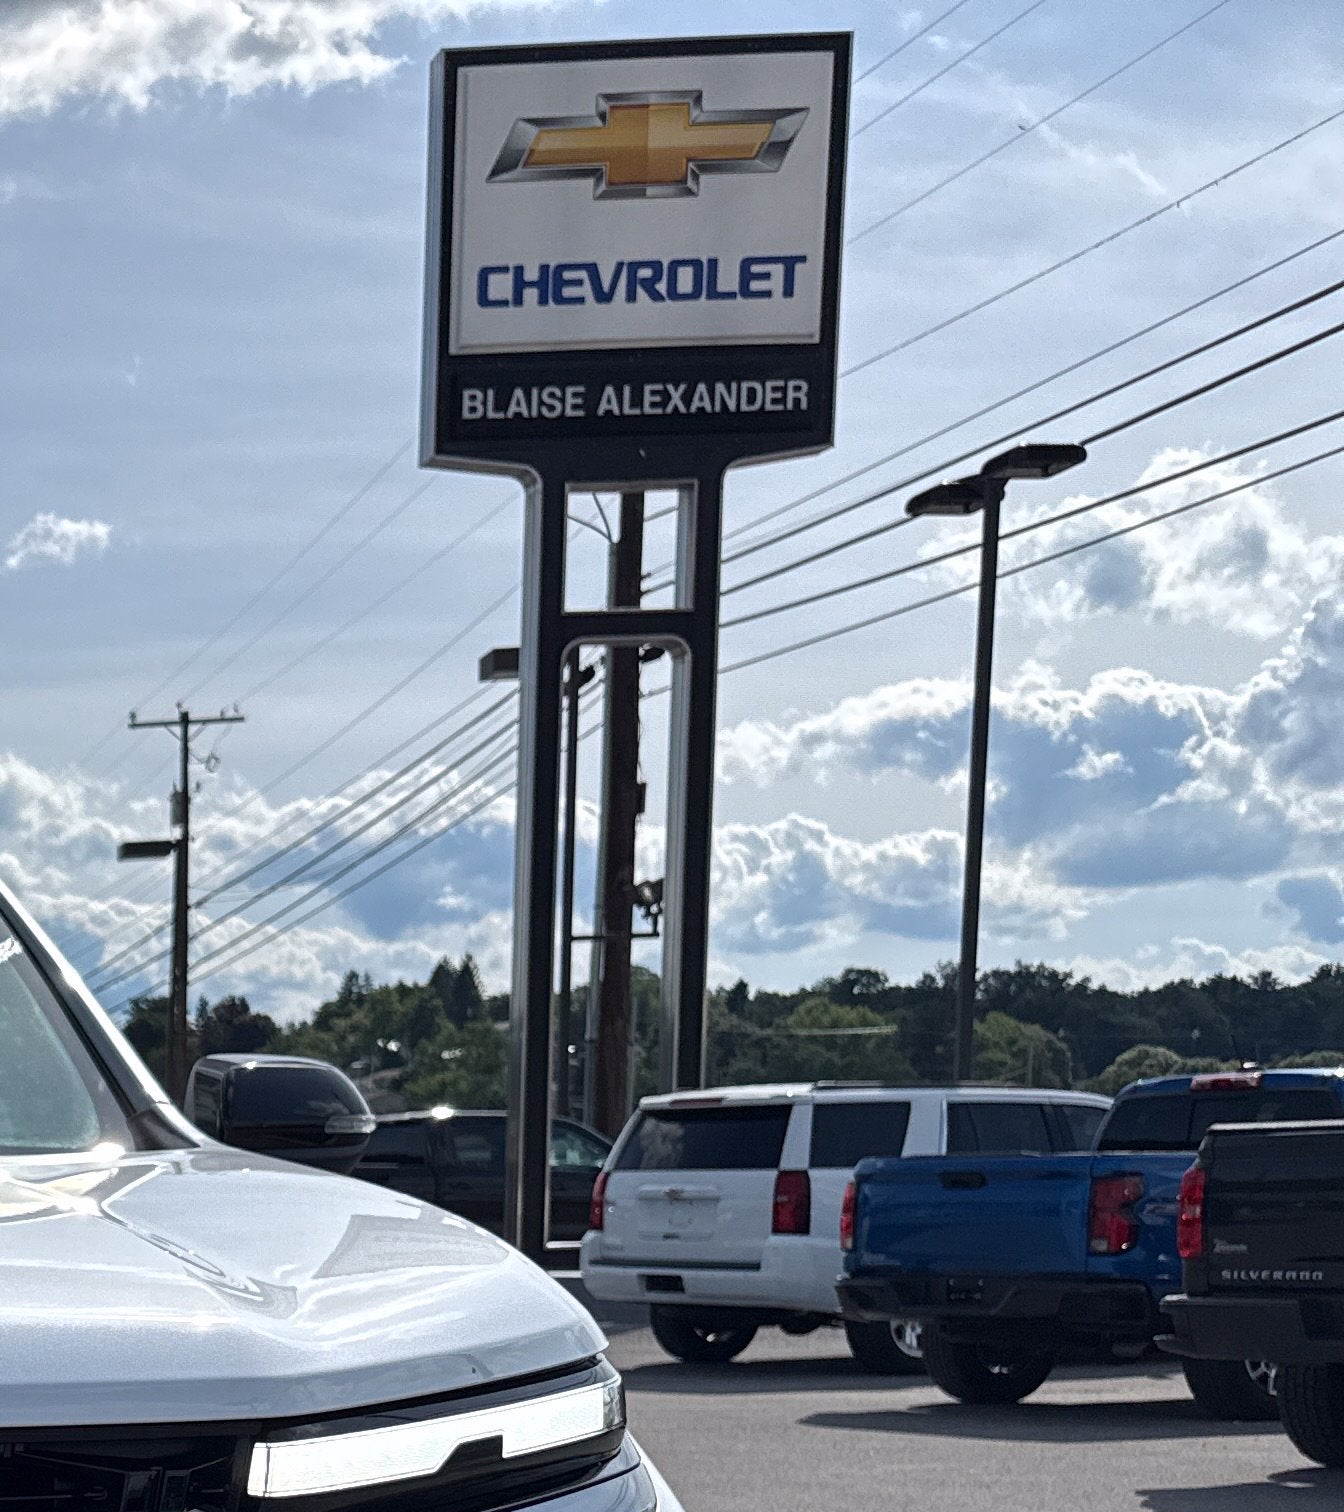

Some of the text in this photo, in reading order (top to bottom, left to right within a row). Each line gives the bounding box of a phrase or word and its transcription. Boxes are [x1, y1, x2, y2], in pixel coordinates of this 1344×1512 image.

[476, 255, 807, 309] CHEVROLET
[461, 379, 809, 421] BLAISE ALEXANDER
[1221, 1269, 1324, 1281] SILVERADO
